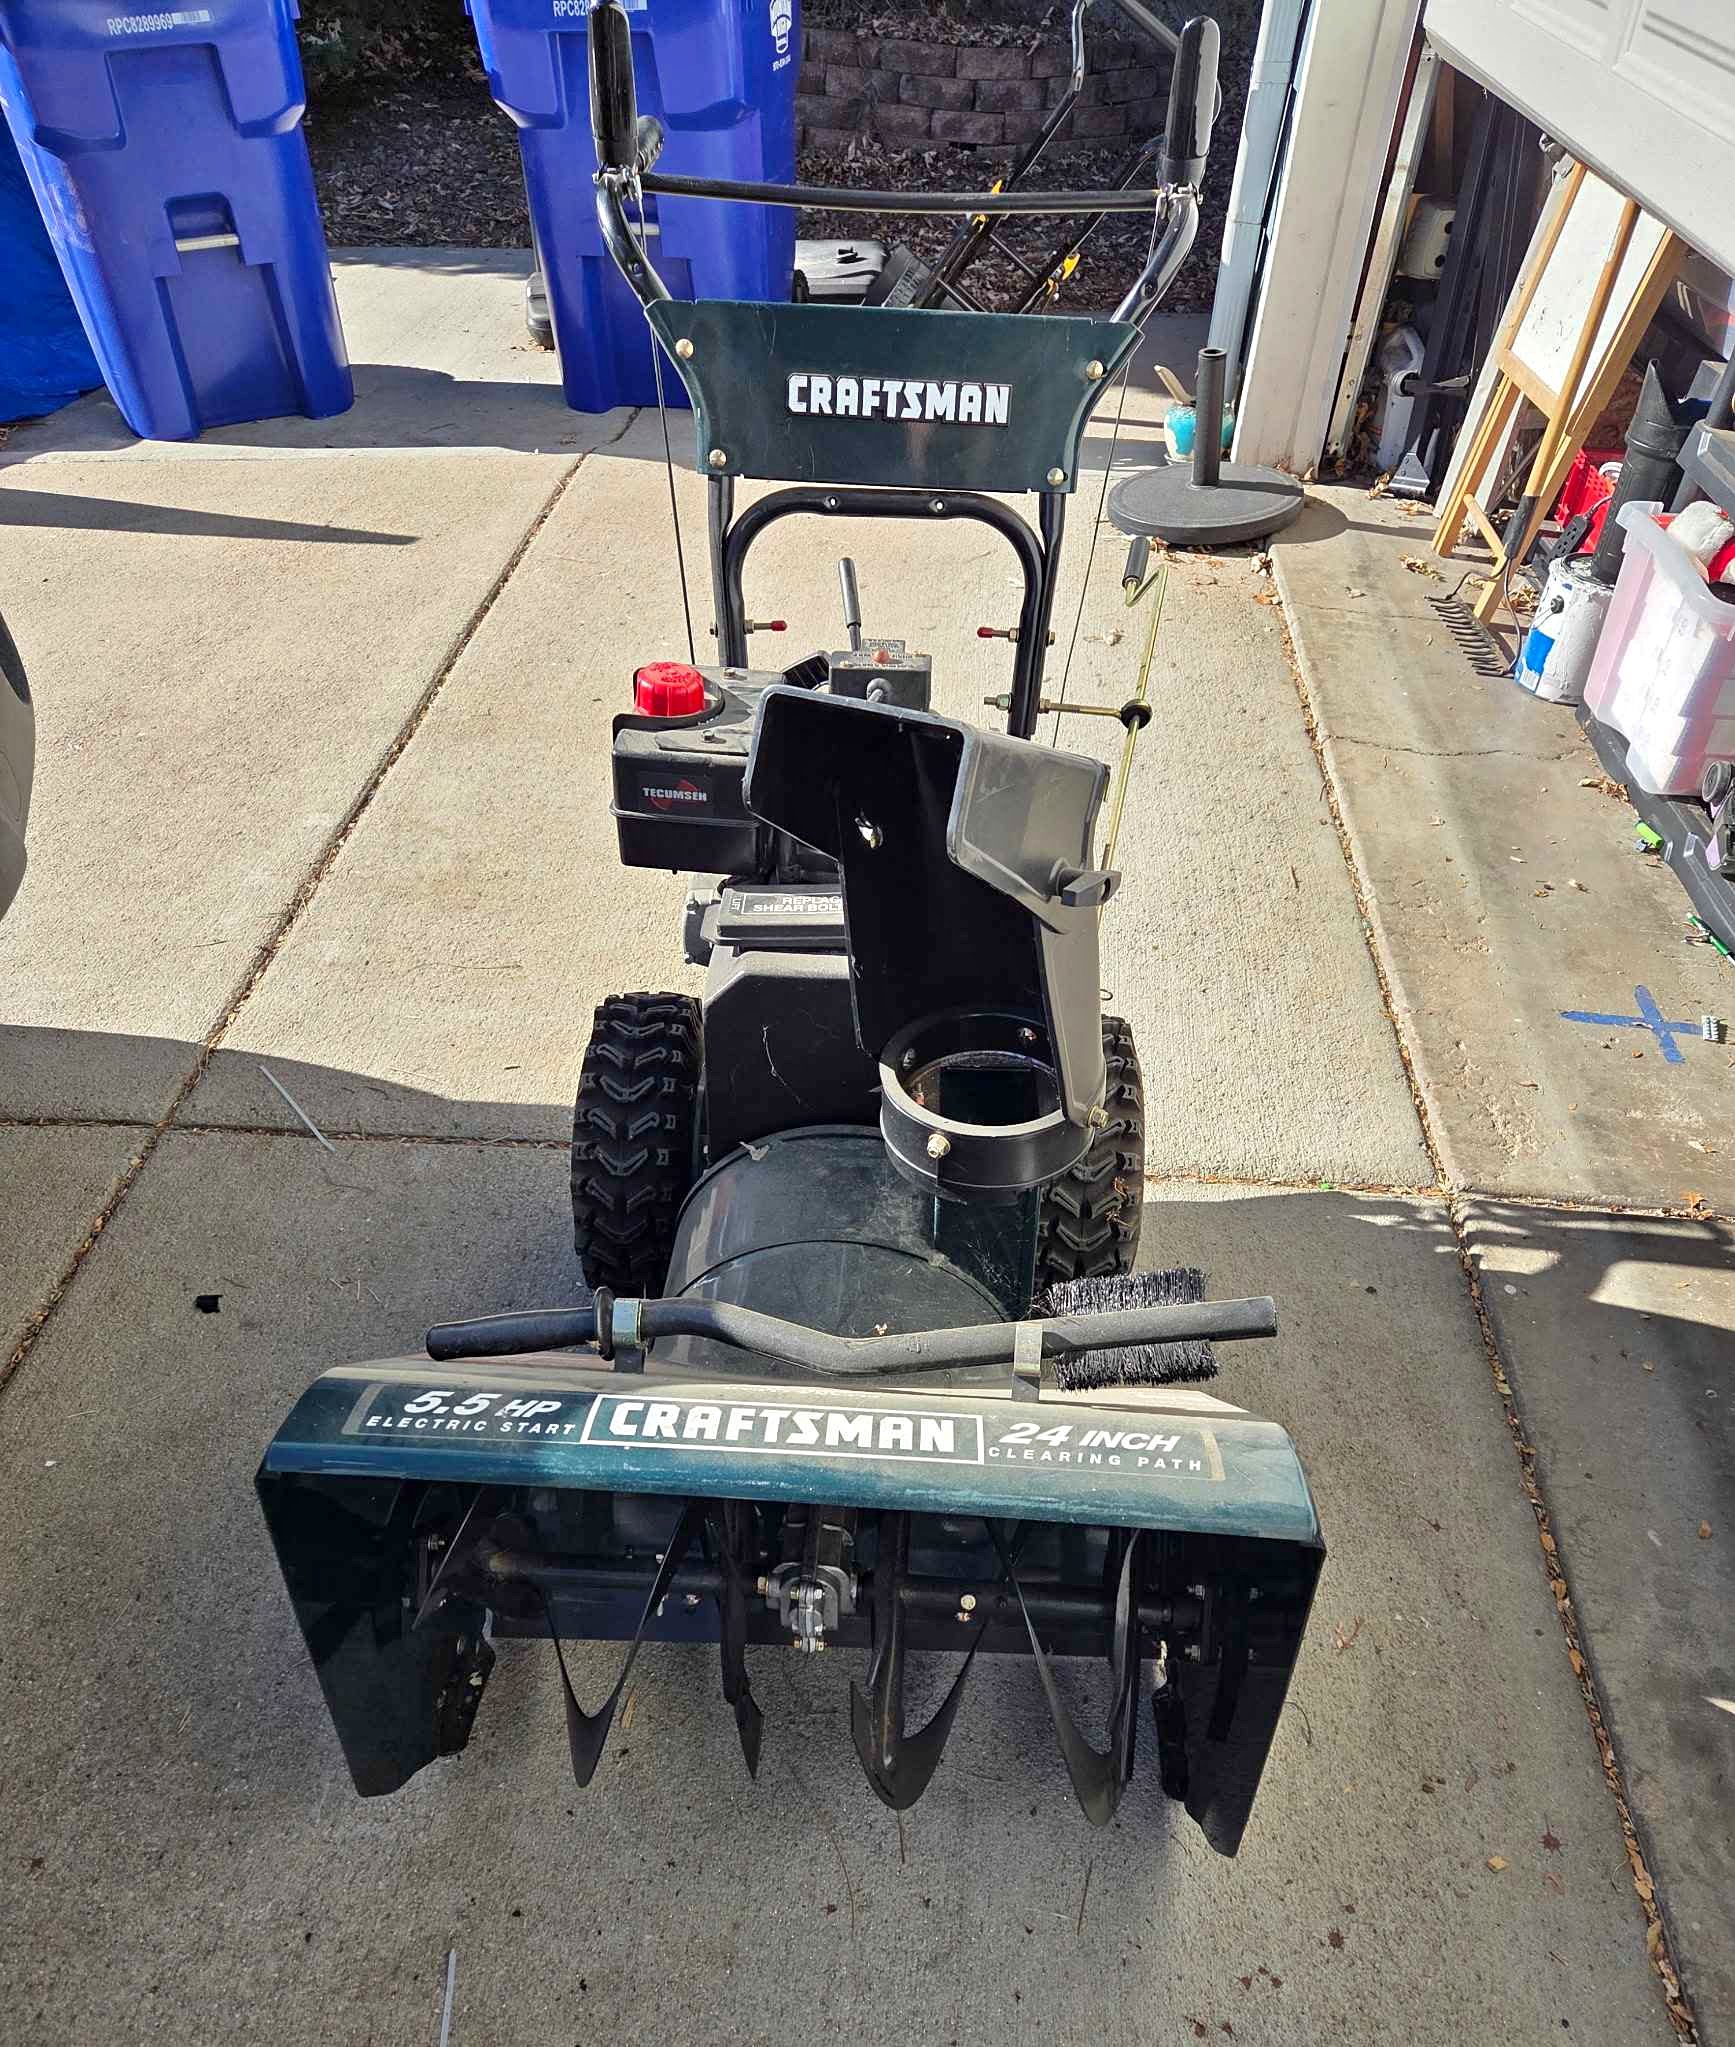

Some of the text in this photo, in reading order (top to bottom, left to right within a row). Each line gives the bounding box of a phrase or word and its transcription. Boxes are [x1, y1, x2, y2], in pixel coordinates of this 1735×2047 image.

[787, 374, 1012, 425] CRAFTSMAN
[642, 787, 707, 801] TECUMSEH
[753, 904, 804, 912] SHEAR
[404, 1390, 562, 1418] 5.5 HP
[366, 1415, 576, 1436] ELECTRIC START
[608, 1401, 955, 1453] CRAFTSMAN
[999, 1422, 1181, 1453] 24 INCH
[988, 1446, 1202, 1471] CLEARING PATH
